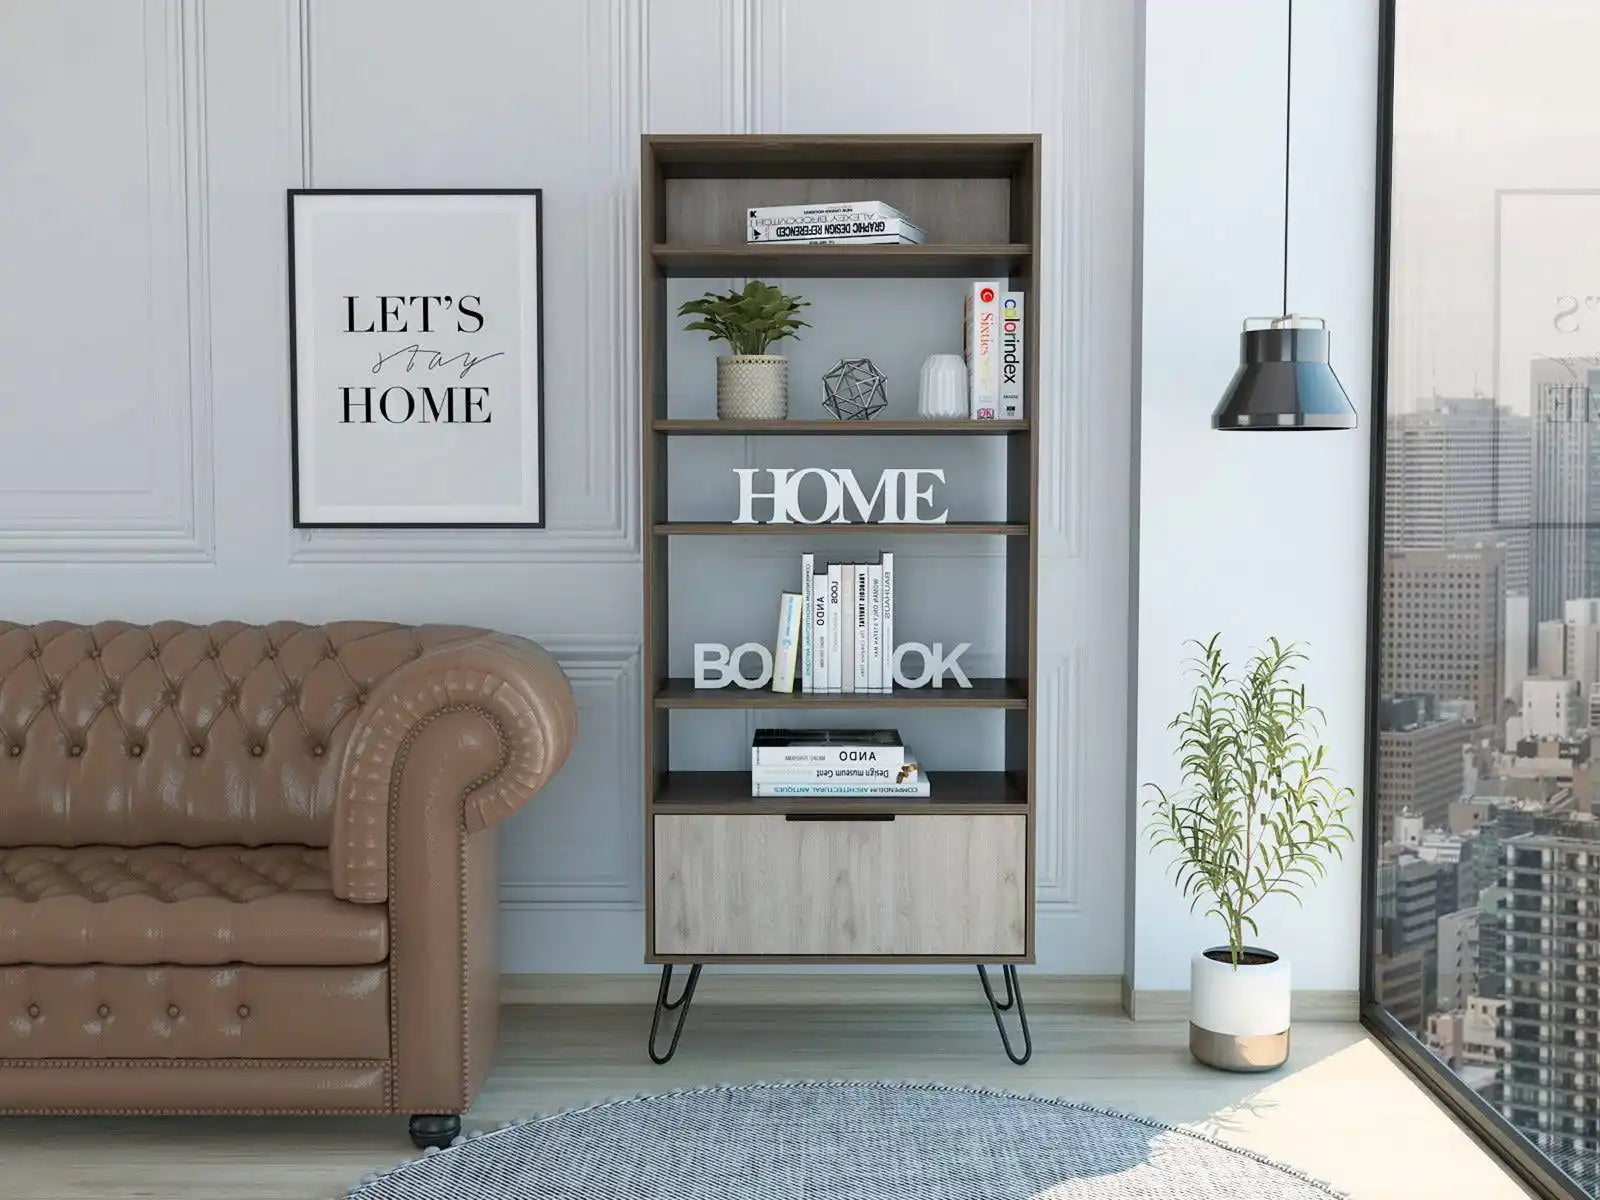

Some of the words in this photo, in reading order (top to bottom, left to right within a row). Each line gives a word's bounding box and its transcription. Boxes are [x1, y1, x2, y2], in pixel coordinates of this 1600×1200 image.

[776, 225, 823, 237] REFERENCED
[824, 224, 851, 237] DESIGN
[852, 222, 885, 234] GRAPHIC
[343, 295, 484, 333] LET'S
[979, 312, 994, 356] Sixties
[1004, 299, 1020, 384] colorindex
[372, 344, 505, 379] stay
[338, 386, 491, 424] HOME
[732, 468, 949, 524] HOME
[816, 770, 833, 778] Gent
[865, 768, 889, 778] Design
